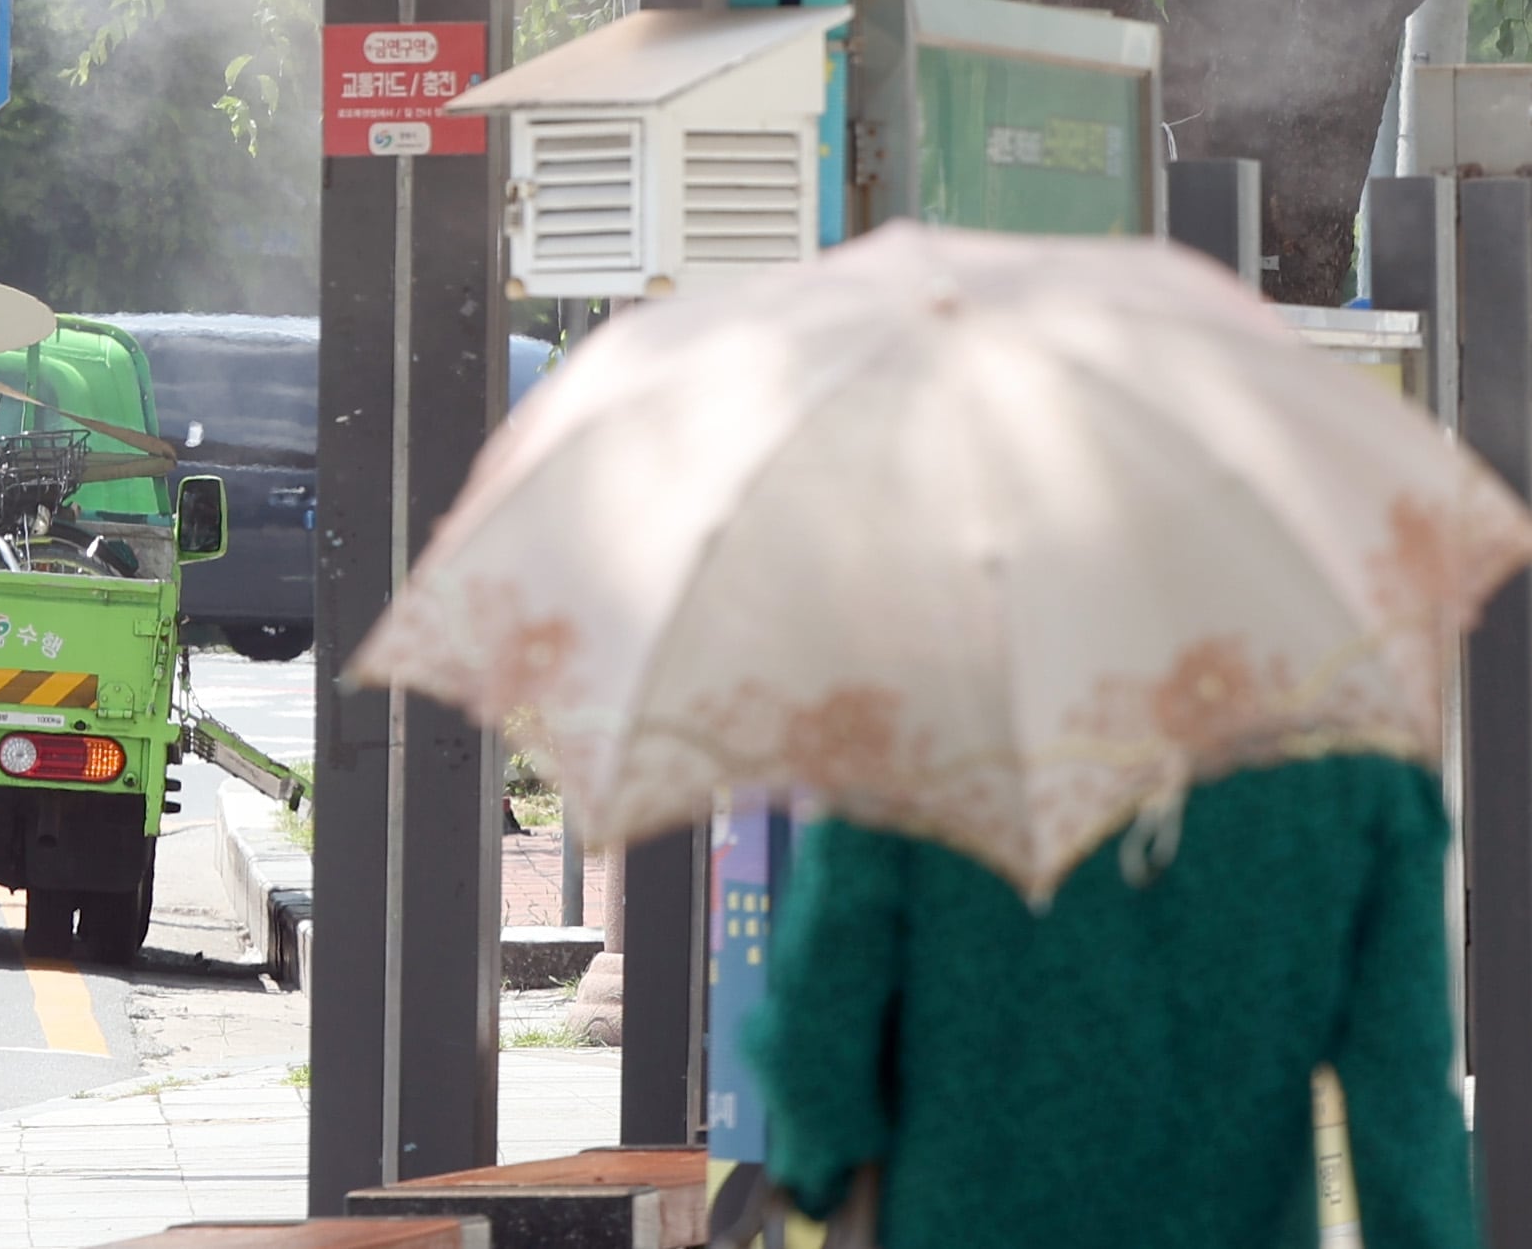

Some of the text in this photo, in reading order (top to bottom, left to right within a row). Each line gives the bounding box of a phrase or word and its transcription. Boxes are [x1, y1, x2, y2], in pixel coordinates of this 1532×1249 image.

[375, 38, 429, 59] 금연구역
[341, 70, 408, 98] 교통카드
[422, 70, 456, 97] 충전
[16, 623, 65, 659] 수행
